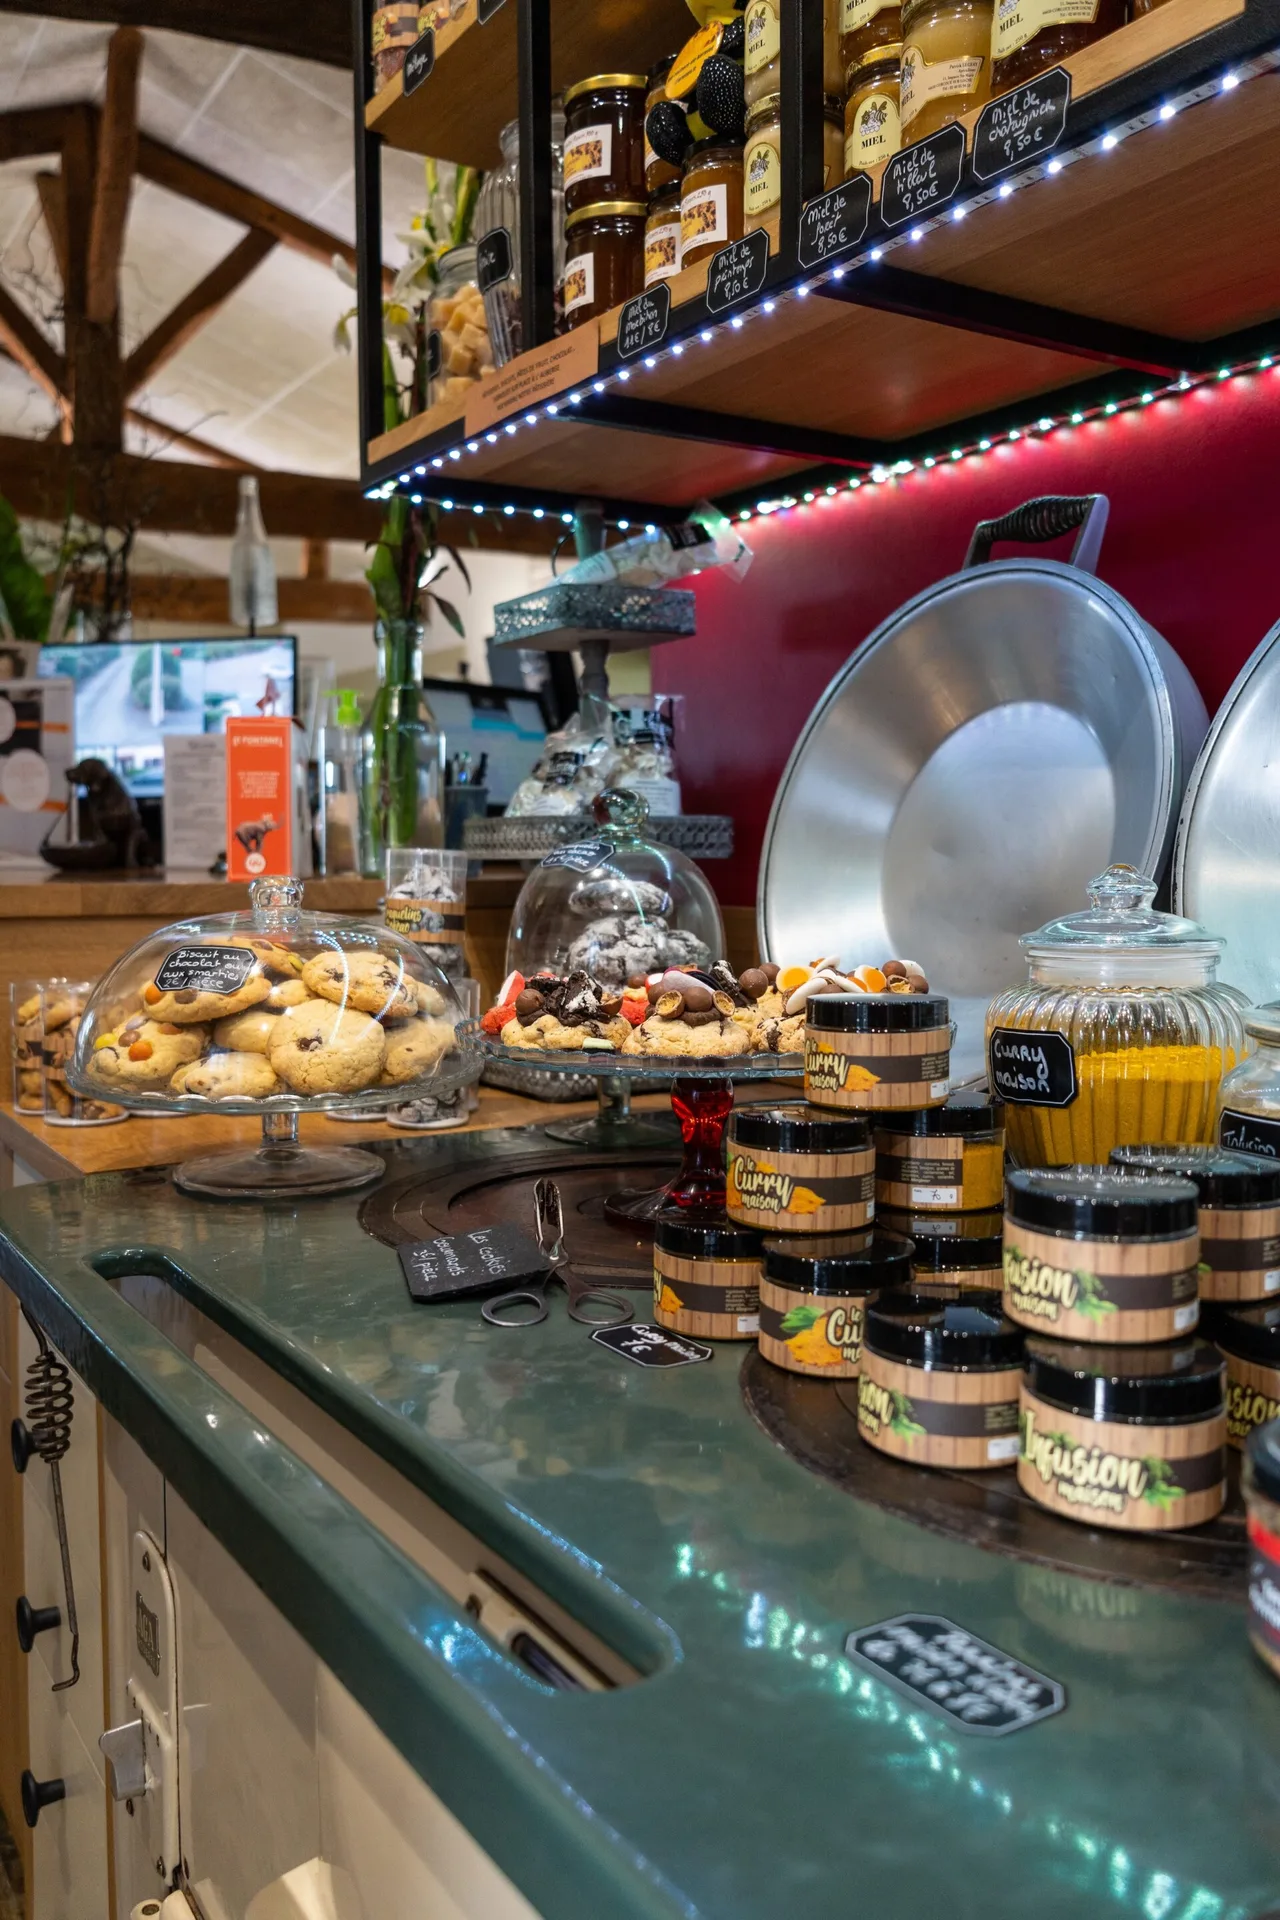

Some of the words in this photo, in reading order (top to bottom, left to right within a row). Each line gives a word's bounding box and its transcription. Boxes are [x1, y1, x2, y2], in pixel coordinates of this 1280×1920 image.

[999, 13, 1024, 35] MIEL
[748, 39, 766, 54] MIEL
[992, 94, 1020, 125] Miel
[1023, 90, 1040, 110] de
[861, 134, 887, 149] MIEL
[893, 149, 919, 179] Miel
[920, 147, 936, 162] de
[749, 182, 769, 196] MIEL
[808, 197, 831, 225] Miel
[833, 194, 847, 213] de
[718, 244, 738, 270] Miel
[740, 243, 751, 258] de
[628, 298, 643, 321] Miel
[169, 958, 221, 968] chocolat
[224, 962, 241, 970] ou
[177, 950, 219, 959] Biscuit
[163, 970, 185, 978] aux
[188, 969, 239, 981] smarties
[804, 1039, 850, 1086] Curry
[996, 1065, 1051, 1093] maison
[734, 1155, 794, 1208] Curry
[741, 1192, 781, 1214] maison
[1011, 1292, 1059, 1322] maison
[1025, 1409, 1149, 1500] Infusion
[1057, 1480, 1126, 1514] maison
